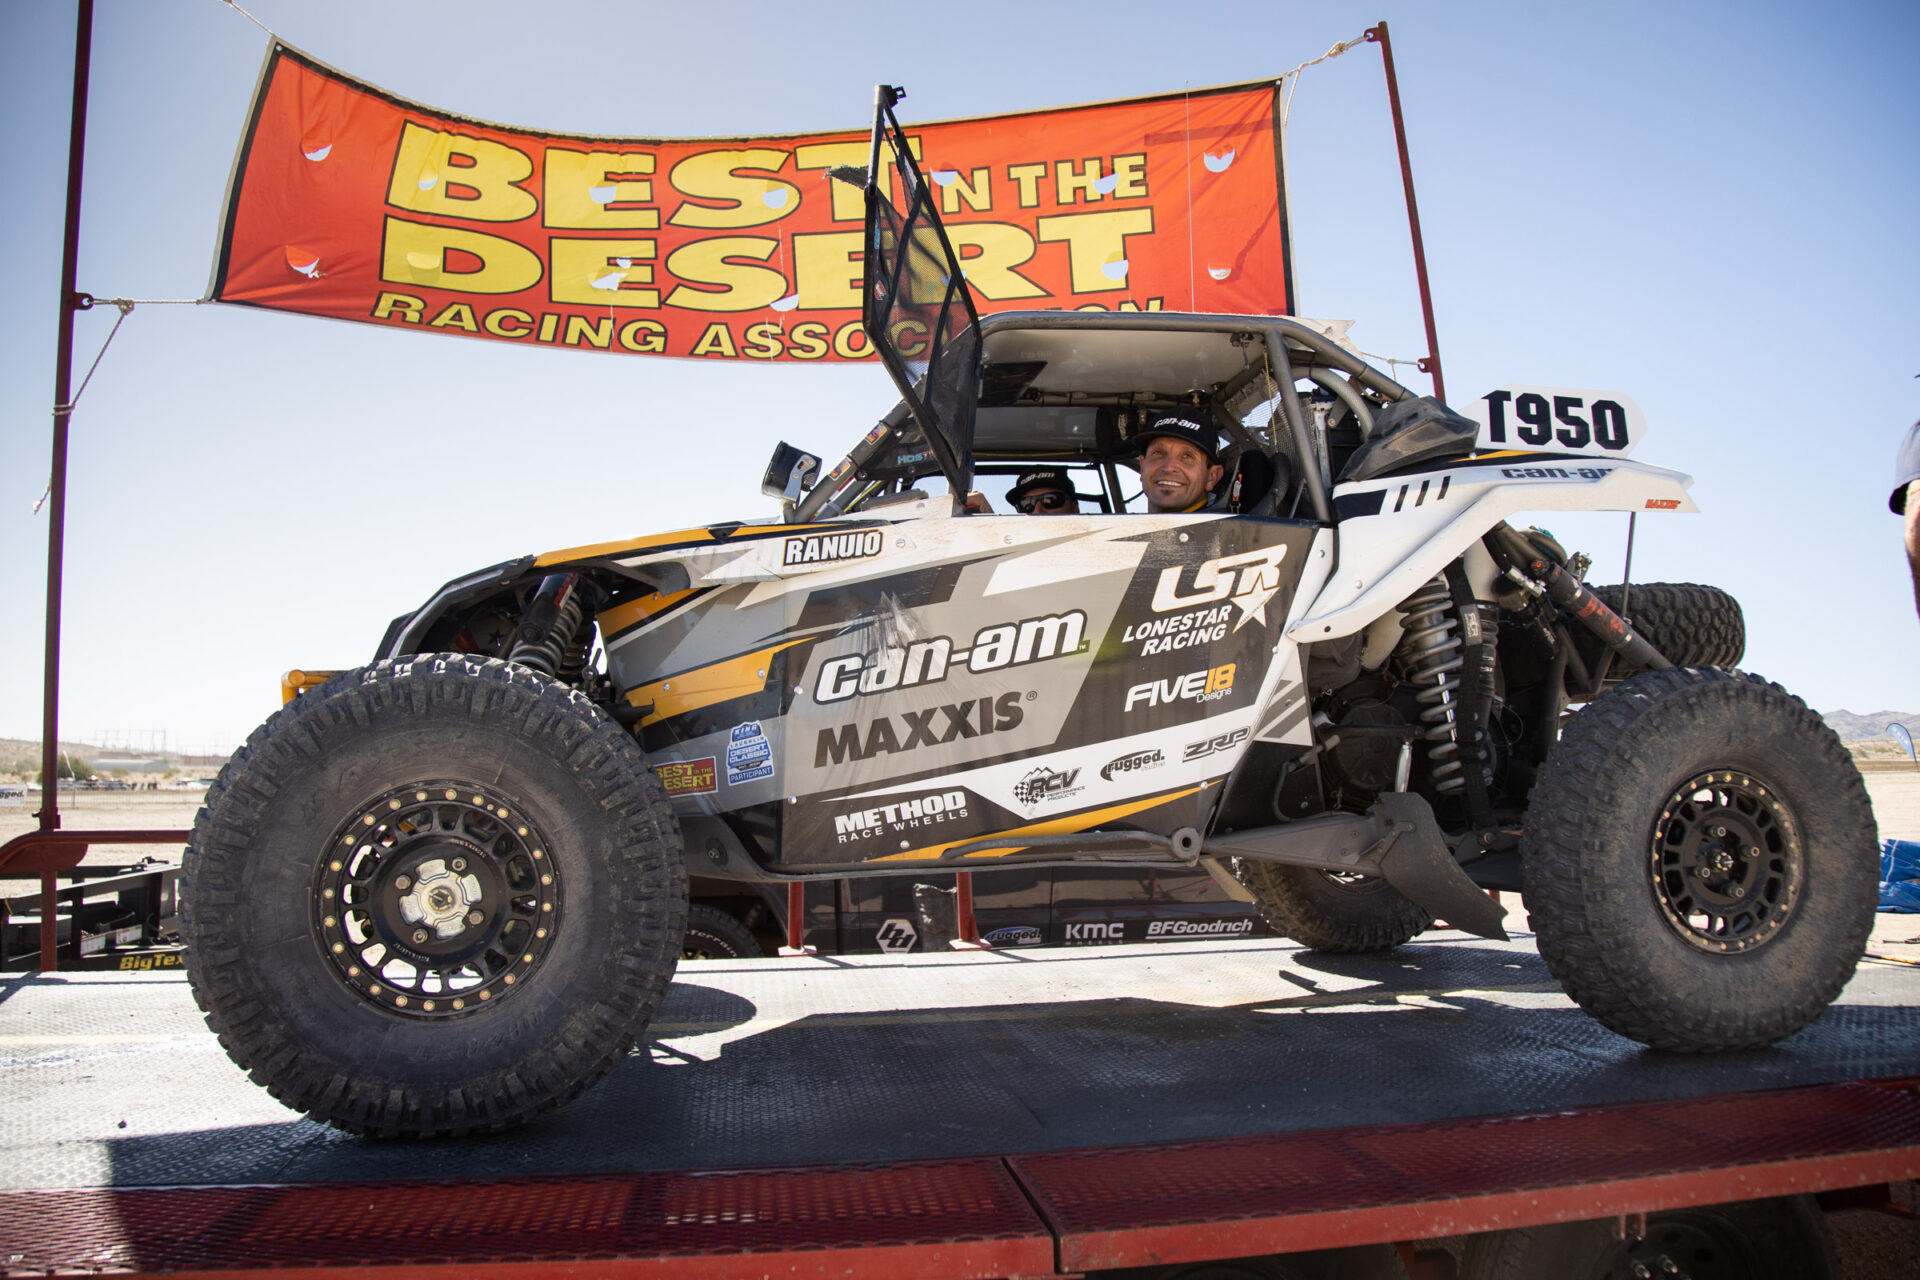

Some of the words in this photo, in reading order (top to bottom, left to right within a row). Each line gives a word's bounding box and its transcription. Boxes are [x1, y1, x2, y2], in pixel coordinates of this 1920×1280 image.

[386, 119, 923, 230] BEST
[1008, 152, 1149, 208] THE
[379, 206, 1155, 313] DESERT
[369, 291, 668, 354] RACING
[1154, 417, 1201, 431] can-am
[1482, 389, 1630, 451] T950
[1020, 472, 1056, 485] can-am
[784, 530, 884, 565] RANUIO
[1151, 544, 1288, 613] LSR
[1122, 604, 1233, 643] LONESTAR
[813, 609, 1089, 705] can-am
[1141, 624, 1228, 657] RACING
[1196, 686, 1232, 703] Designs
[729, 749, 769, 763] CLASSIC
[730, 743, 767, 757] DESERT
[1182, 725, 1250, 763] ZRP
[663, 772, 714, 790] ESERT
[730, 767, 771, 782] PARTICIPANT
[1027, 767, 1082, 796] RCV
[1046, 785, 1086, 798] PERFORMANCE
[1047, 792, 1077, 802] PRODUCTS
[834, 791, 967, 835] METHOD
[838, 827, 884, 844] RACE
[893, 809, 969, 832] WHEELS
[1147, 919, 1253, 935] BFGoodrich
